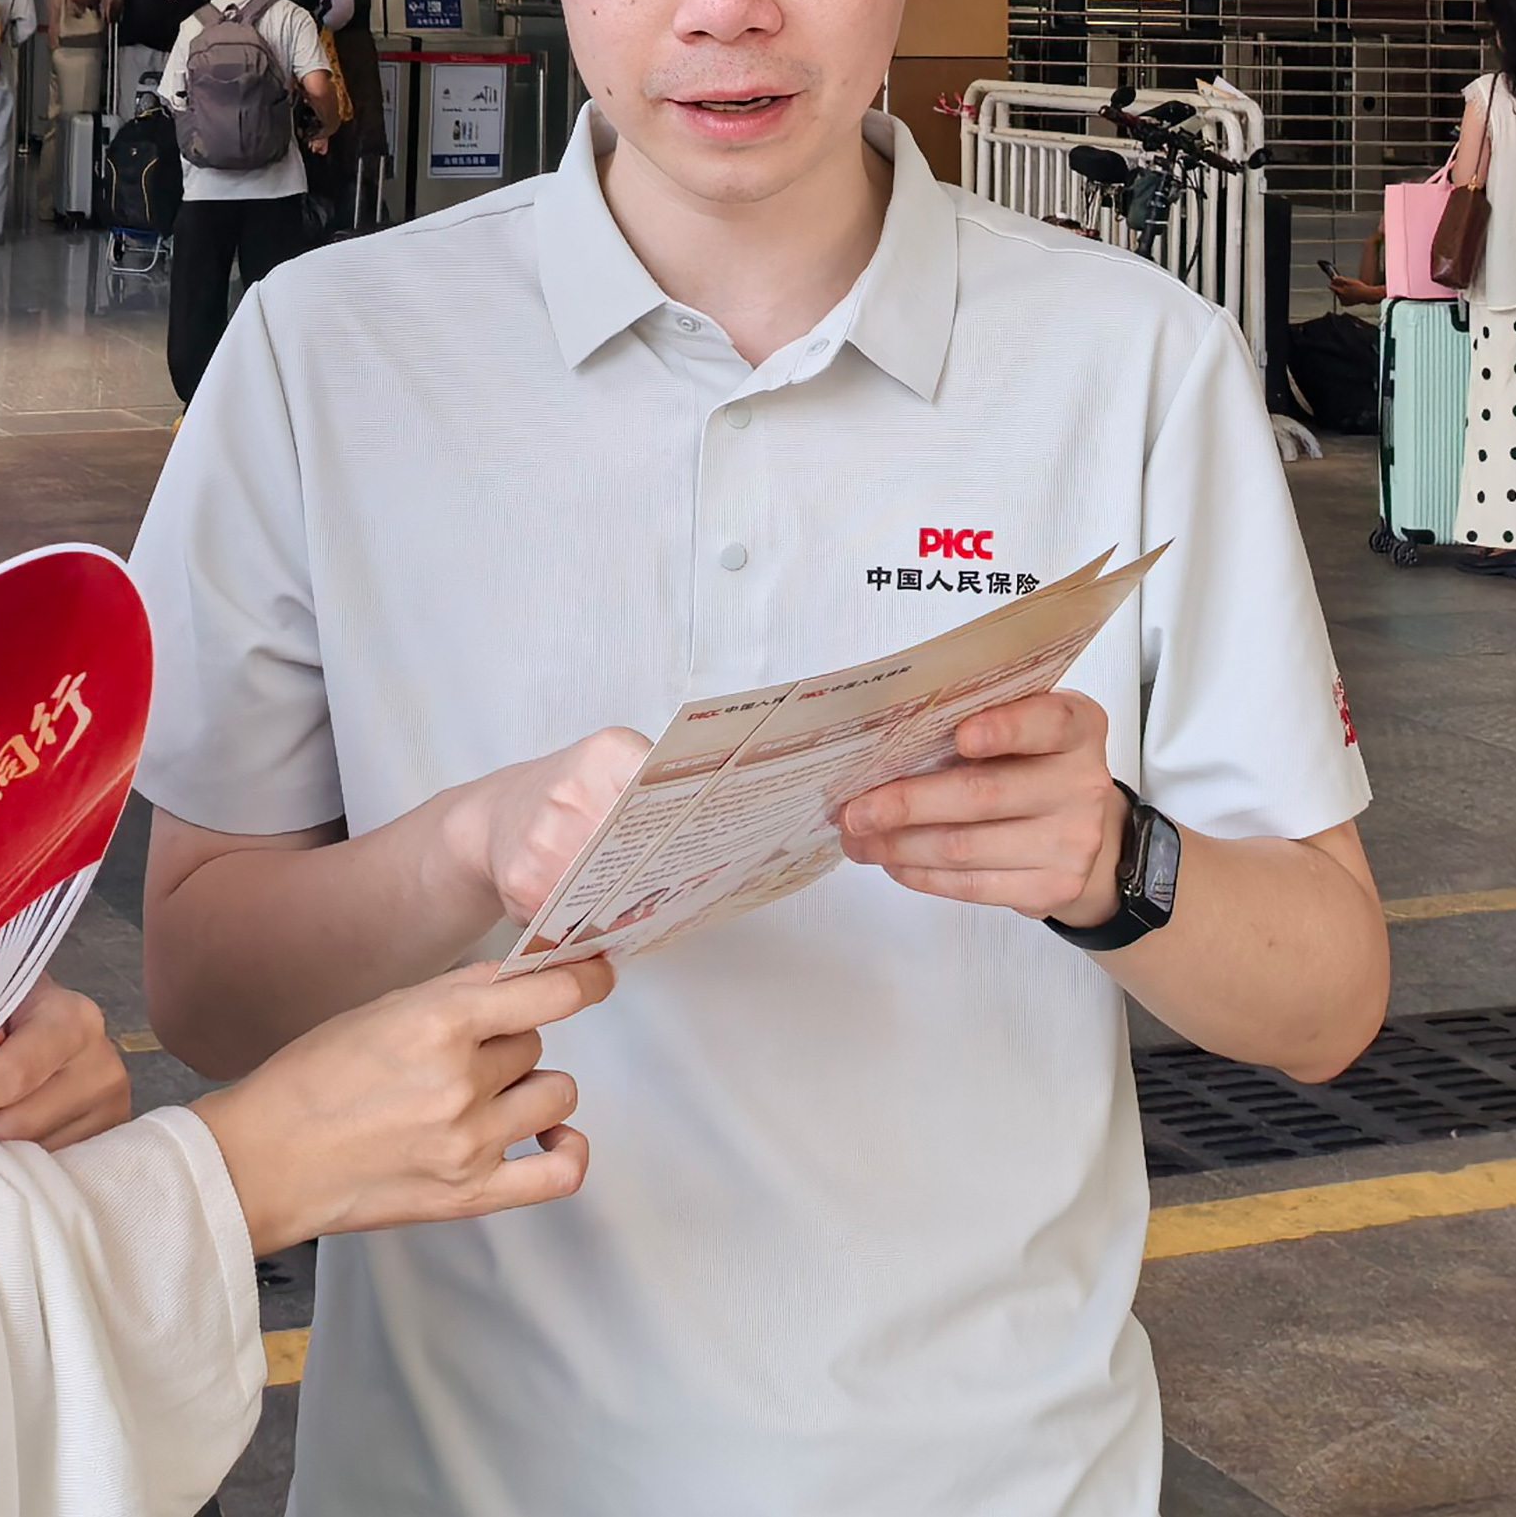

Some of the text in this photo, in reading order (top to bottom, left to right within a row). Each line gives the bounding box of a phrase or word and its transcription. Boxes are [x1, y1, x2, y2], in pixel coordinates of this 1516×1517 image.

[919, 527, 994, 561] PICC
[866, 566, 1041, 596] 中国人民保险
